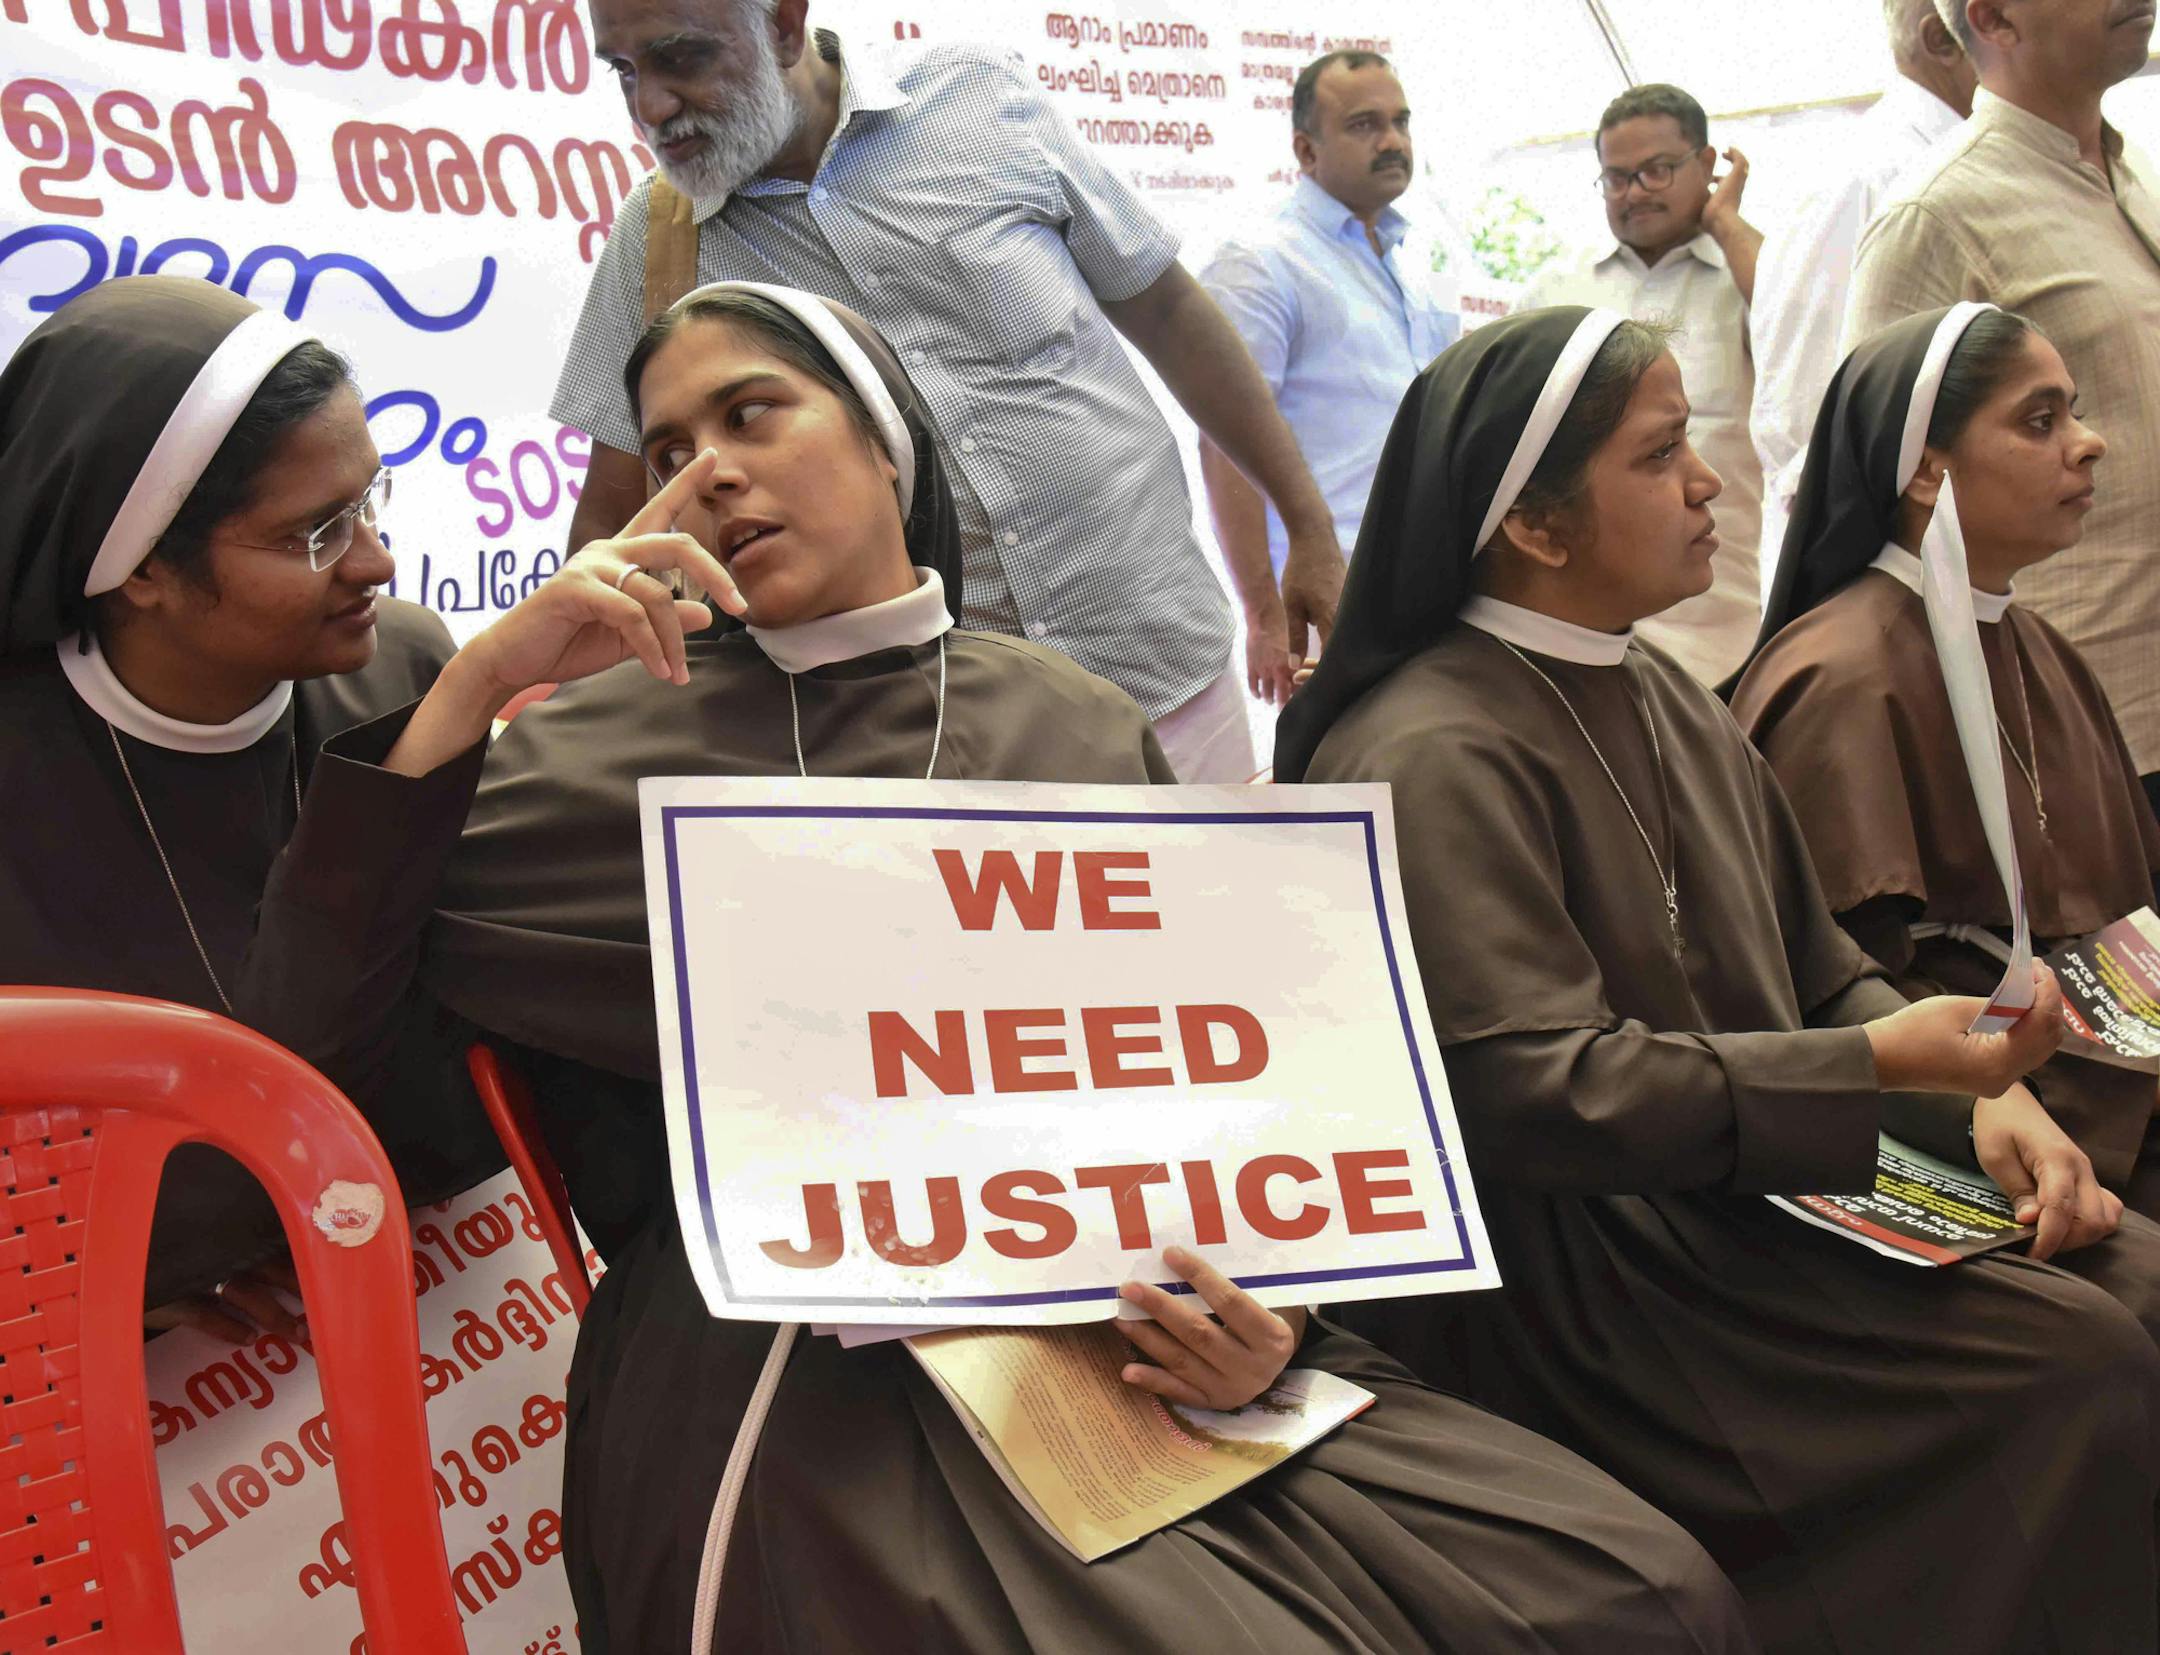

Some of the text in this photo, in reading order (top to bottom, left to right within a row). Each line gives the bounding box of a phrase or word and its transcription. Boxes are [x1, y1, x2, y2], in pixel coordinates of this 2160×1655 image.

[1047, 12, 1209, 54] ആറാം പ്രമാണം
[1127, 70, 1226, 105] മെത്രാനെ
[0, 78, 298, 217] ഉടൻ
[932, 849, 1162, 931] WE
[867, 1004, 1269, 1098] NEED
[758, 1148, 1427, 1270] JUSTICE
